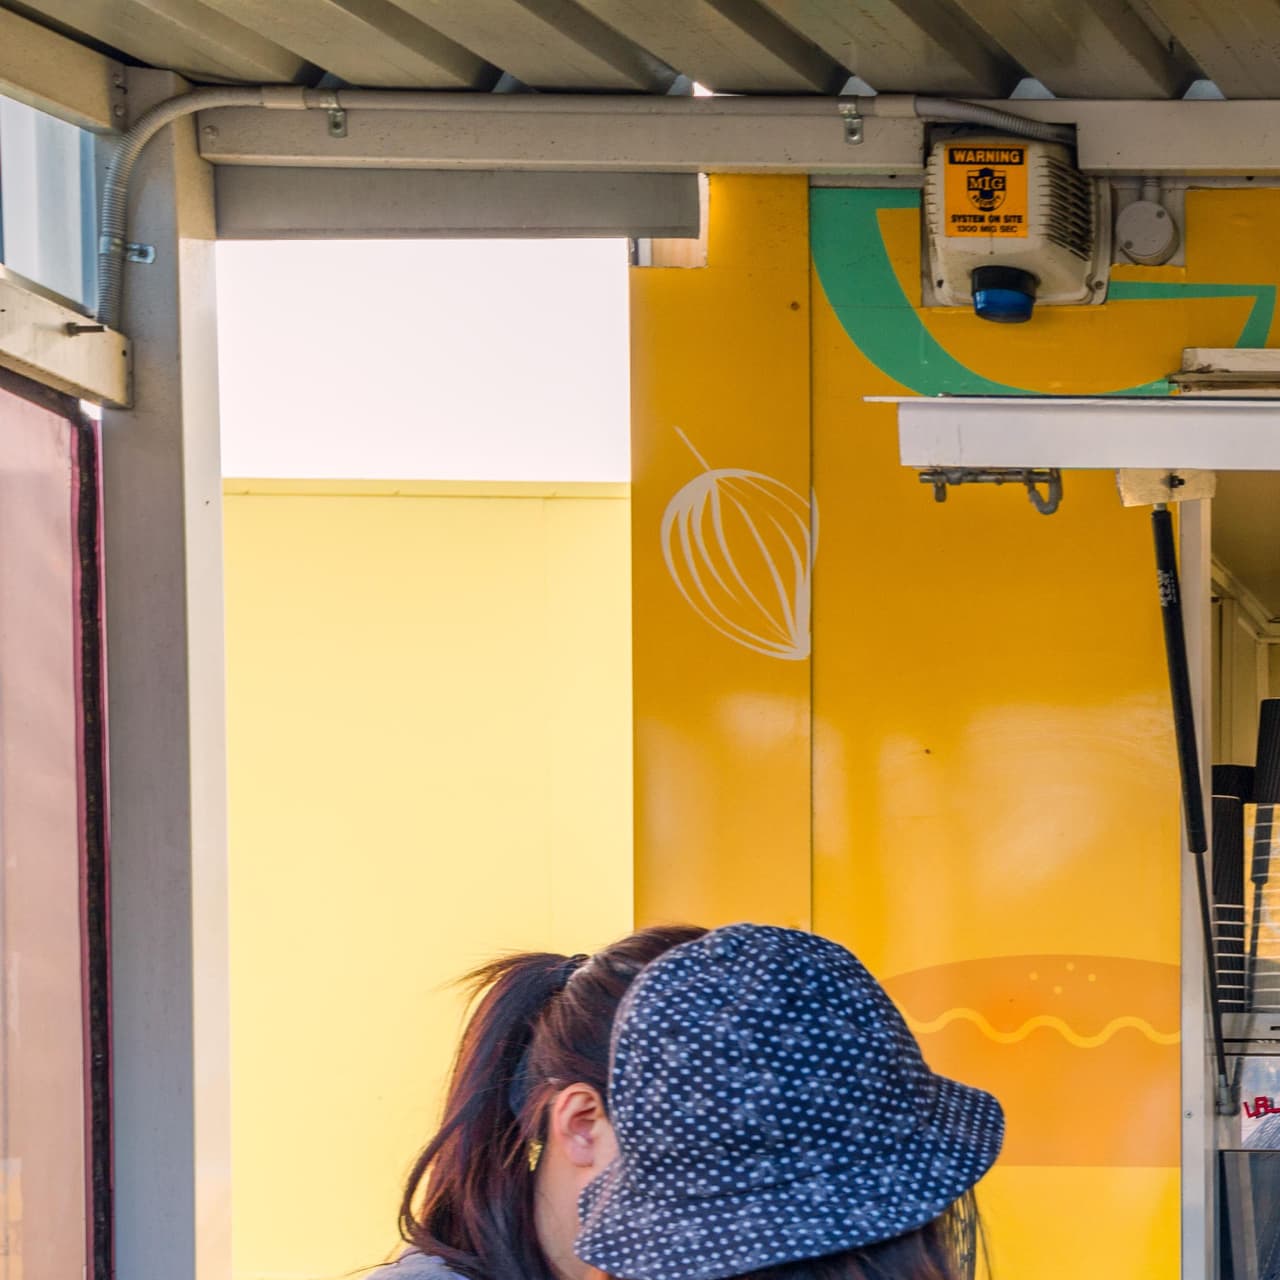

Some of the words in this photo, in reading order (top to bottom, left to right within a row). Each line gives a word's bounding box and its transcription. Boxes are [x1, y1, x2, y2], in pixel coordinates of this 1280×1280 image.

[953, 150, 1020, 163] WARNING
[968, 176, 1004, 190] MIG
[951, 214, 985, 223] SYSTEM
[988, 214, 1000, 223] ON
[1003, 214, 1023, 223] SITE
[957, 225, 978, 233] 1300
[980, 225, 997, 233] MIG
[1000, 225, 1018, 233] SEC
[1243, 1096, 1269, 1118] LA
